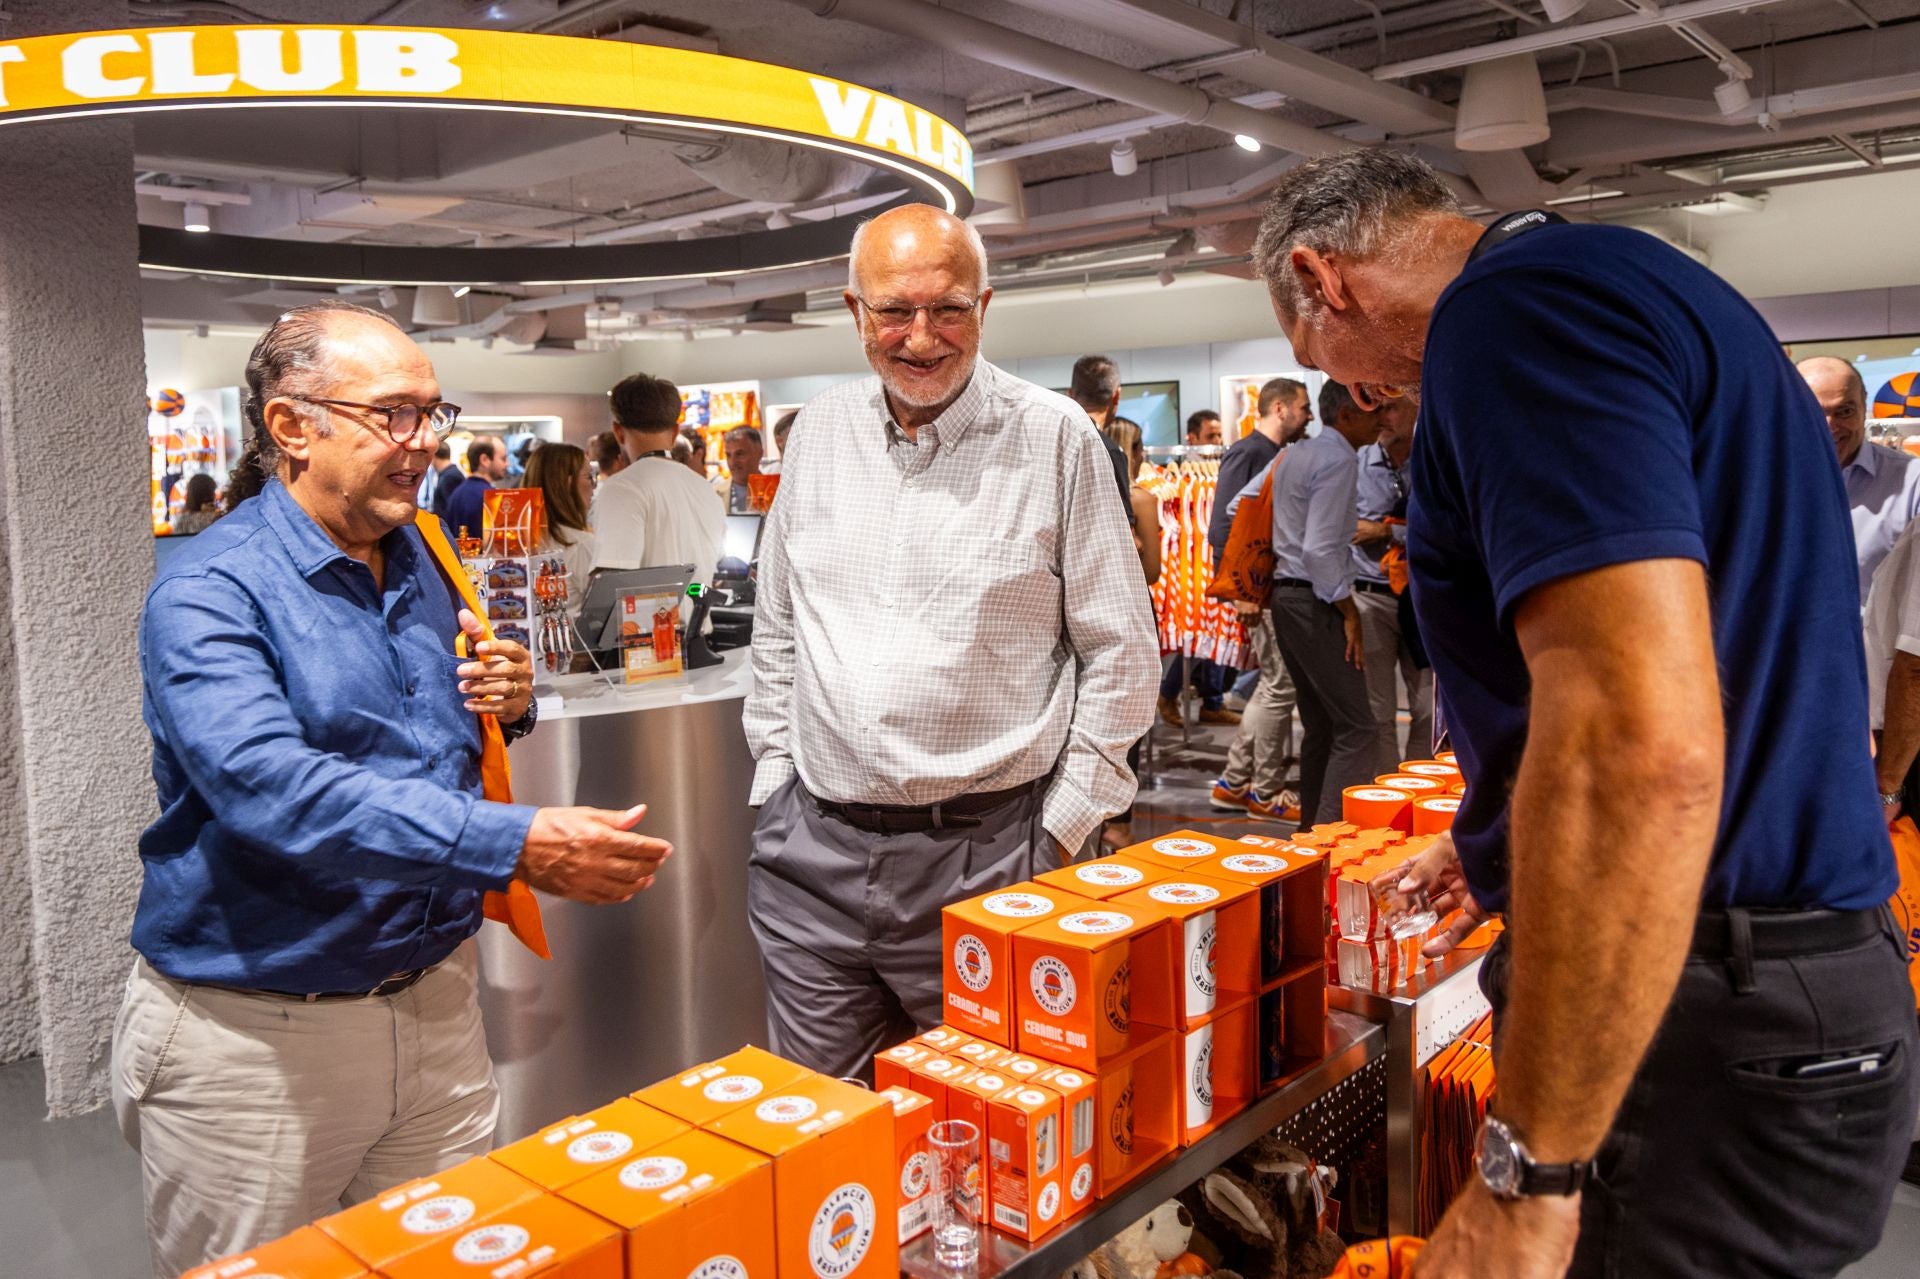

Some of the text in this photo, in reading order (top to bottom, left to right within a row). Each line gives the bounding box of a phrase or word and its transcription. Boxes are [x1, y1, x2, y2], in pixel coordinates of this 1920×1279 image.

[60, 29, 463, 98] CLUB
[1036, 959, 1069, 977] VALENCIA
[948, 991, 981, 1018] CERAMIC
[982, 1004, 1001, 1025] MUG
[1024, 1019, 1064, 1042] CERAMIC
[1065, 1030, 1088, 1049] MUG
[817, 1188, 865, 1225] VALENCIA
[817, 1229, 870, 1274] BASKET CLUB
[693, 1262, 737, 1279] ENCIA
